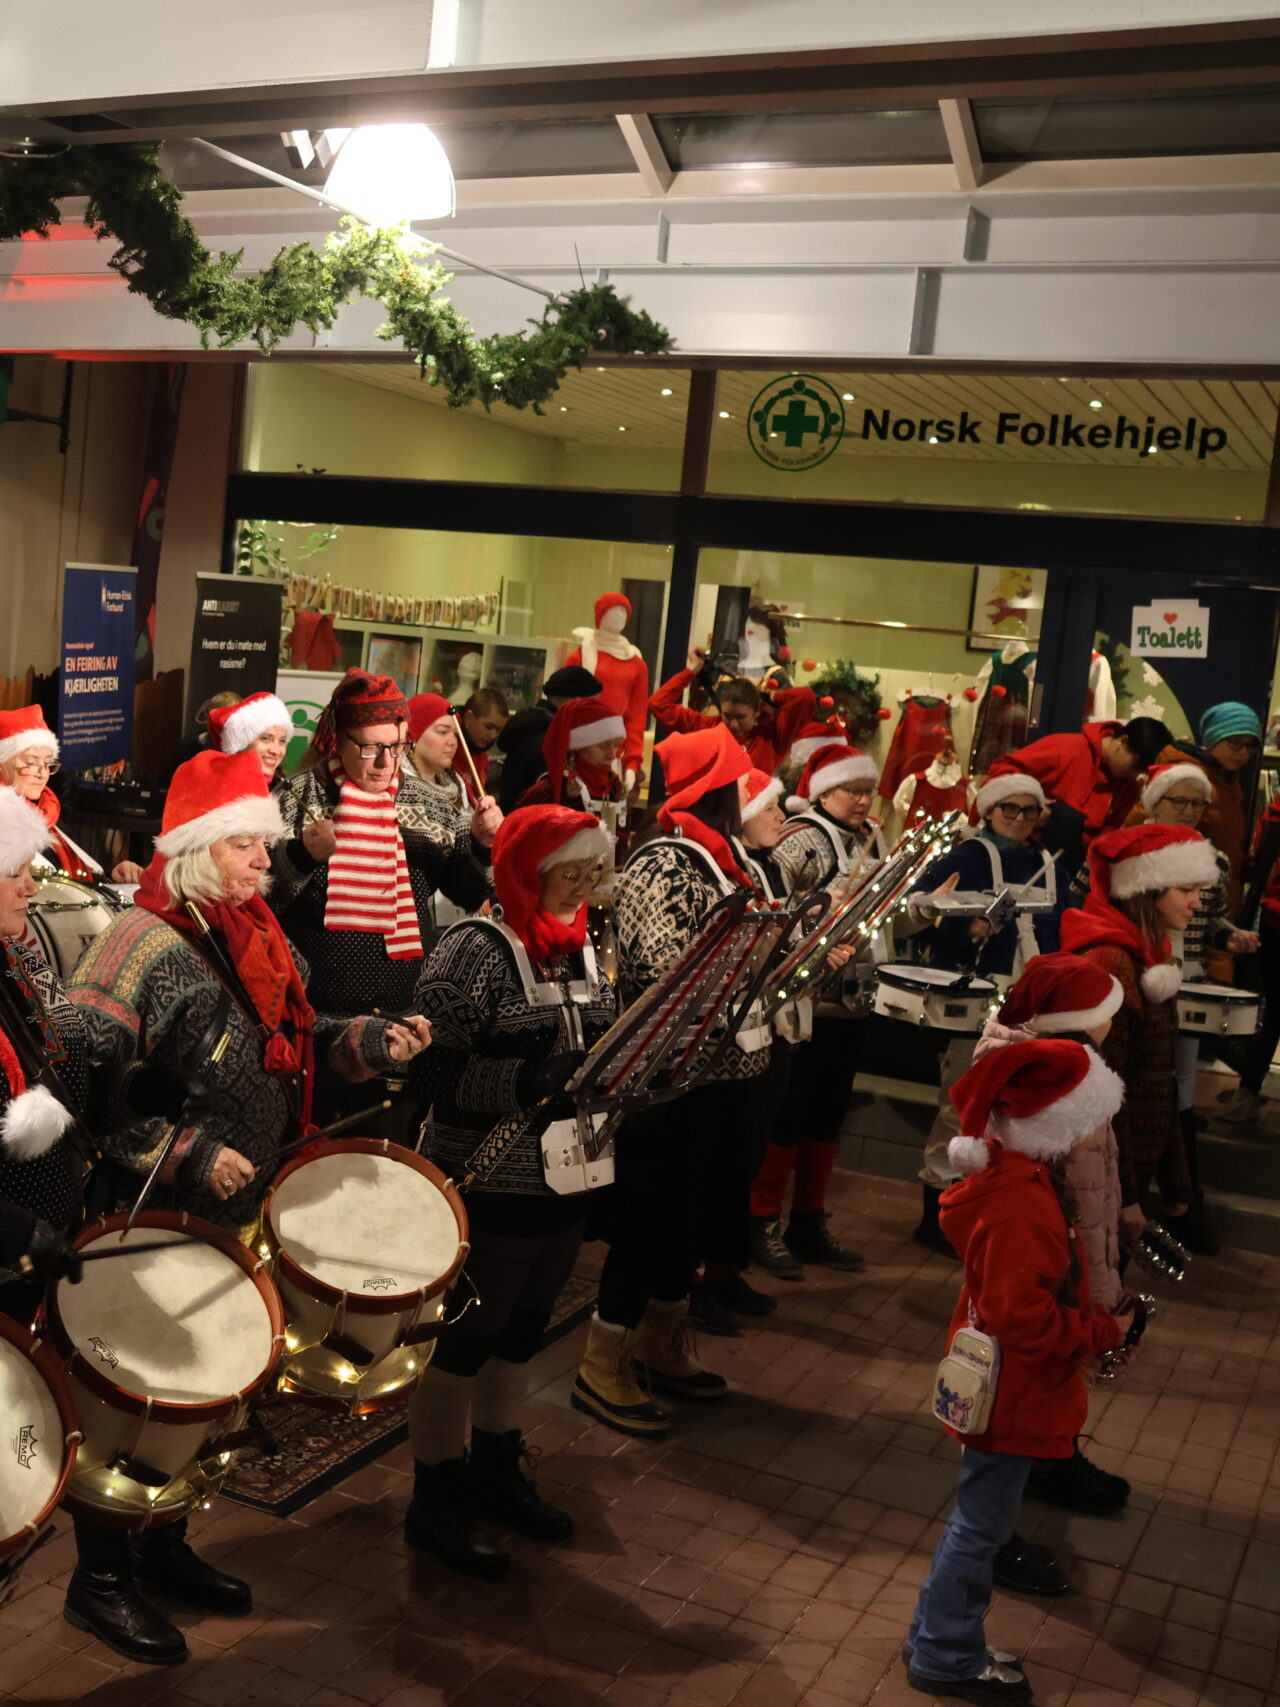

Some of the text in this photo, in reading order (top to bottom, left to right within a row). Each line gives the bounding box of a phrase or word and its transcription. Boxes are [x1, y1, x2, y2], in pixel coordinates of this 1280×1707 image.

[861, 409, 1228, 460] Norsk Folkehjelp
[1137, 626, 1203, 649] Toalett
[65, 656, 118, 672] EN FEIRING AV
[64, 677, 119, 697] KJÆRLIGHETEN
[20, 1430, 29, 1463] REMO
